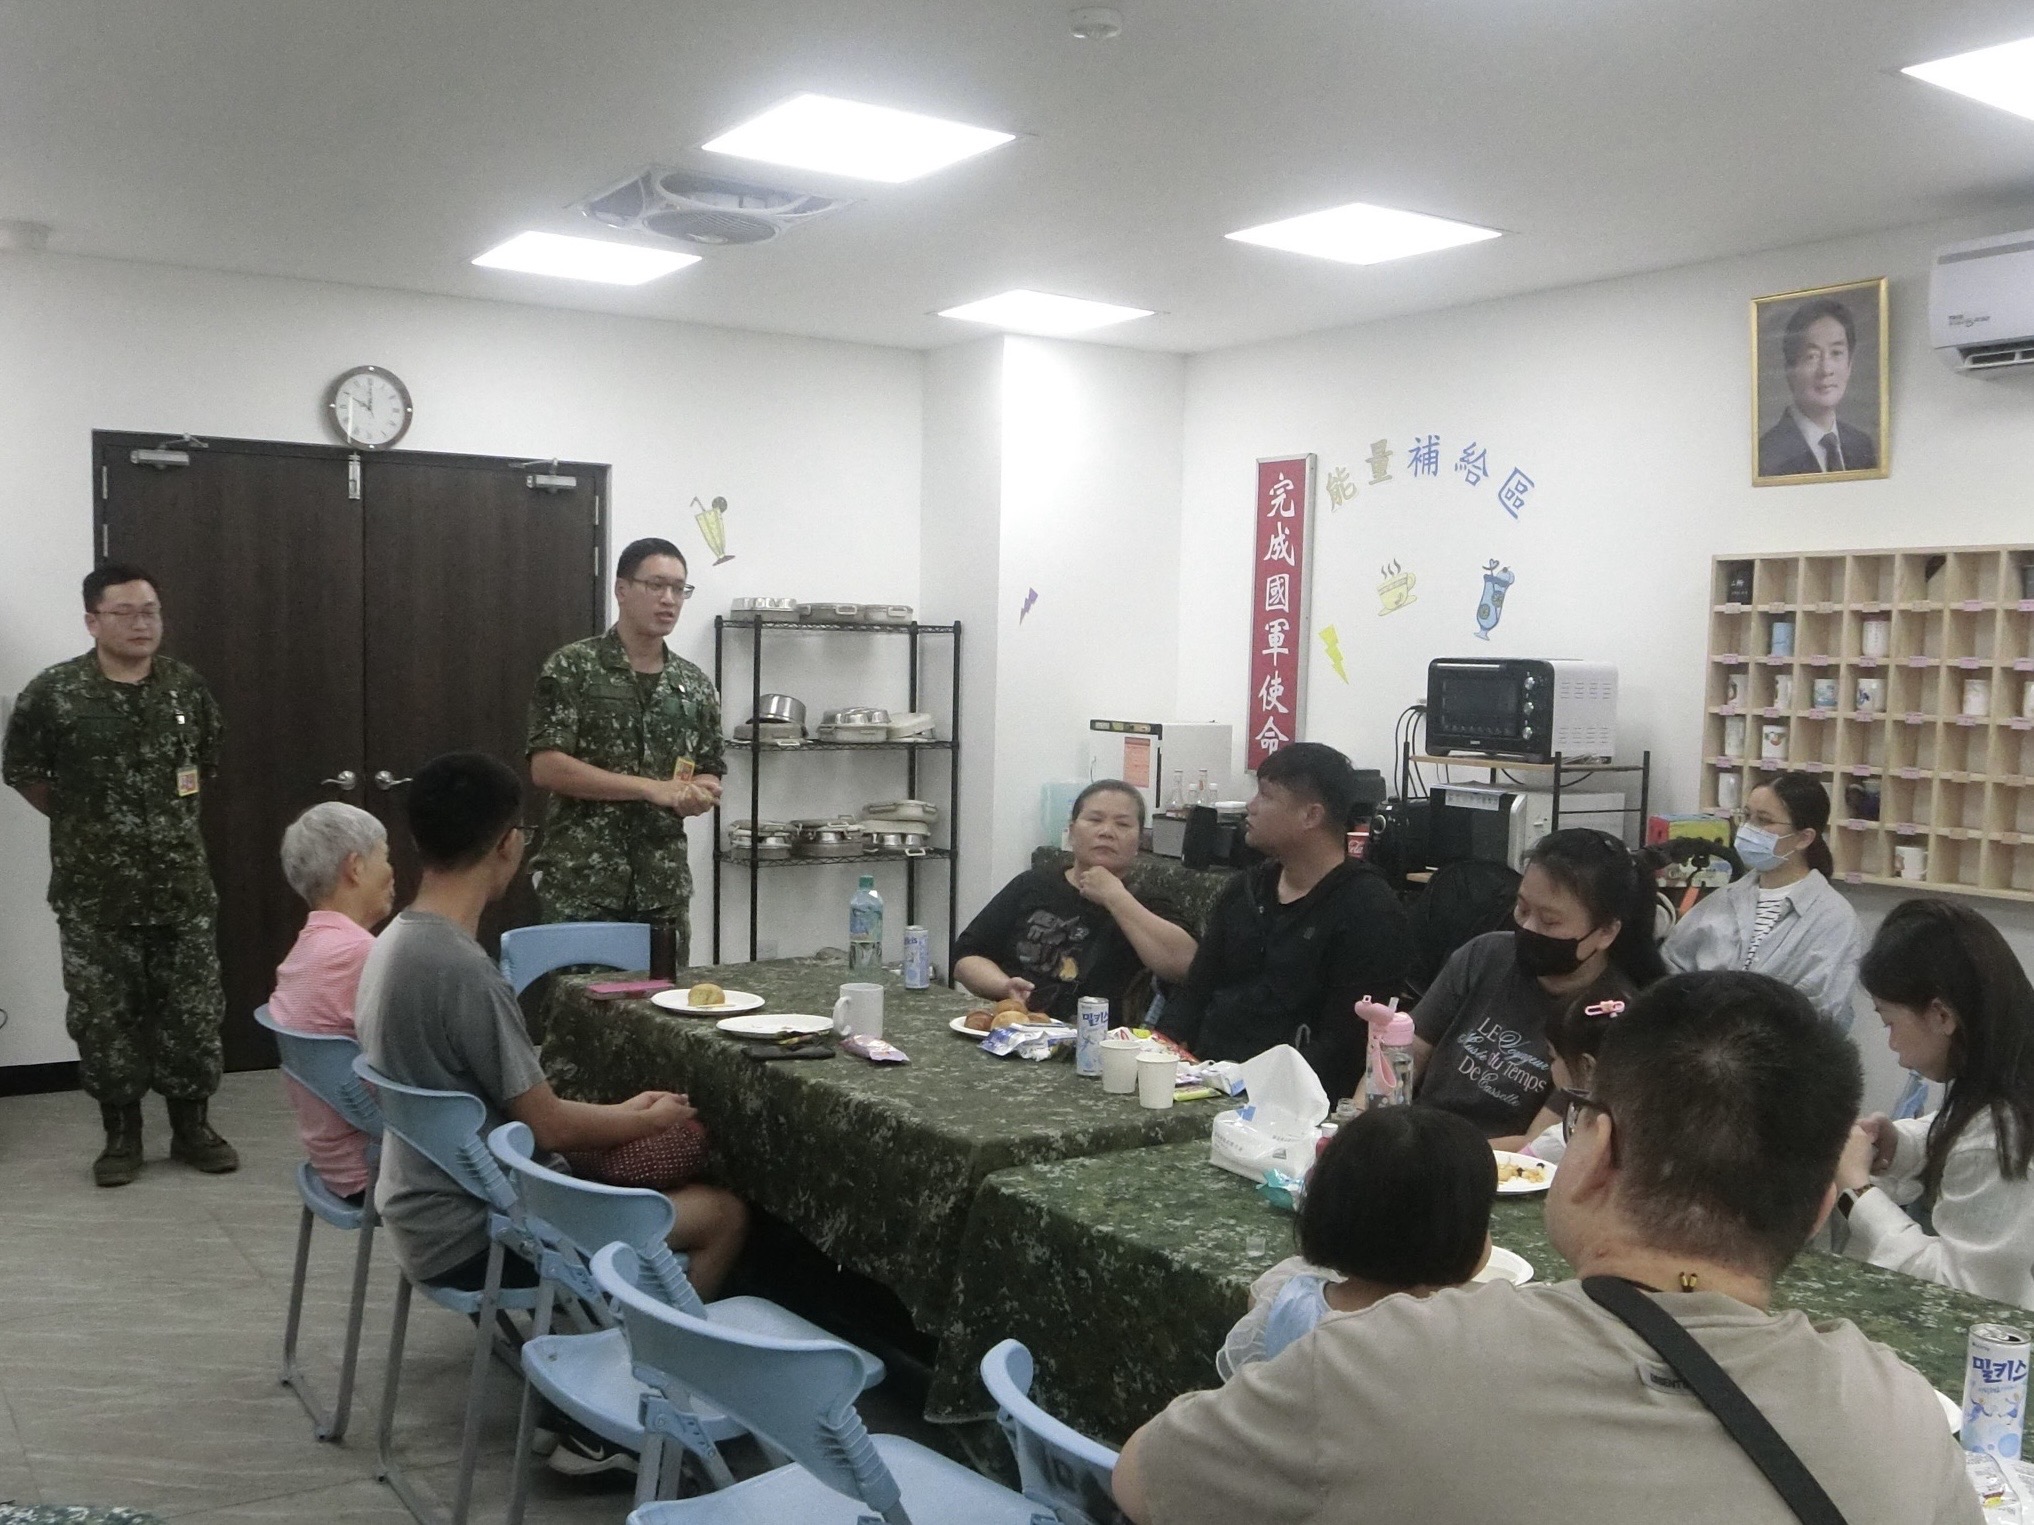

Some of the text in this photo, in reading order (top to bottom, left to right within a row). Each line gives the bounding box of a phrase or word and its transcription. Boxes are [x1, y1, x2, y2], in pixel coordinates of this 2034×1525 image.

[1325, 434, 1535, 520] 能量補給區
[1255, 472, 1296, 756] 完成國軍使命
[1477, 1017, 1503, 1043] LE
[1459, 1055, 1481, 1081] De
[1503, 1061, 1547, 1092] Temps
[1972, 1356, 2028, 1383] 밀키스
